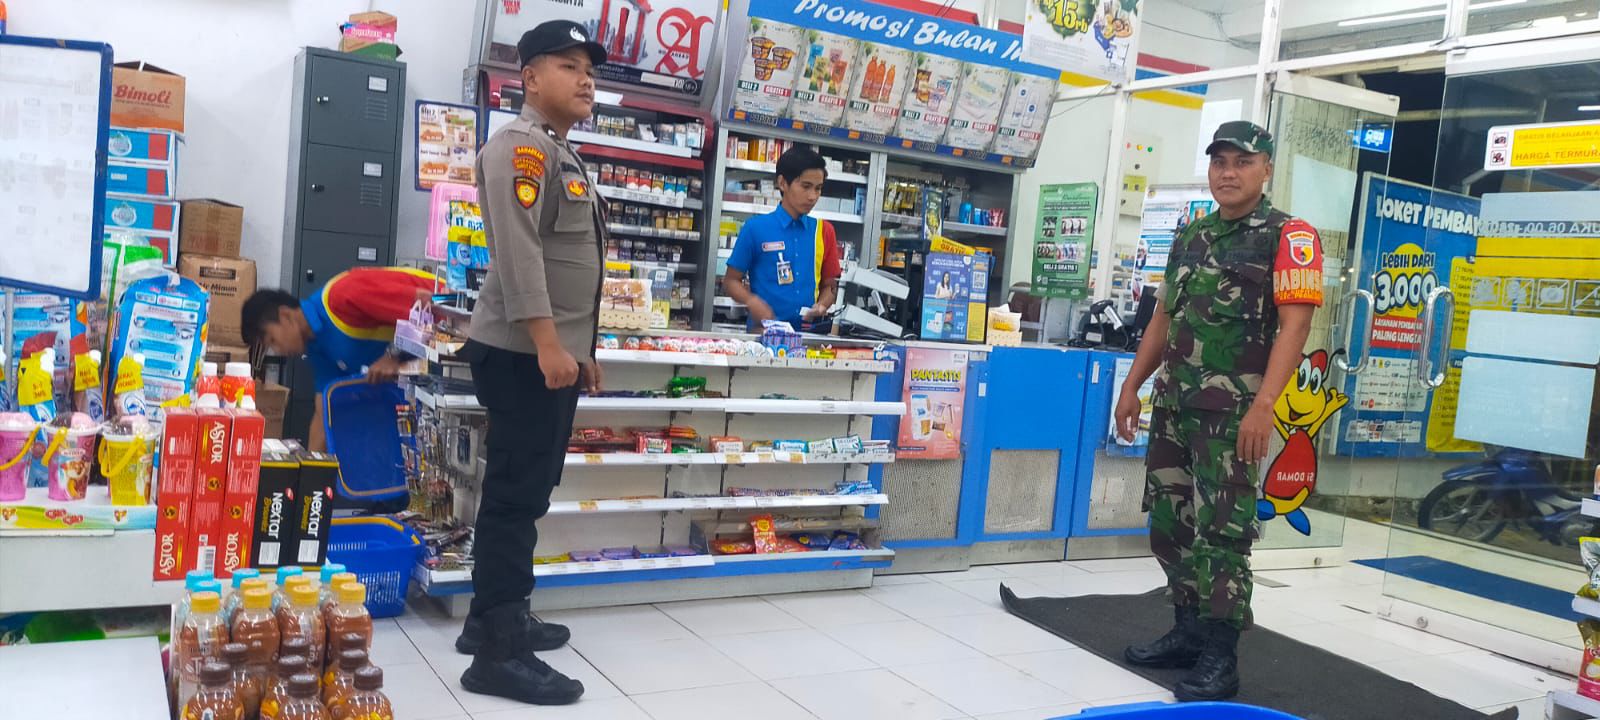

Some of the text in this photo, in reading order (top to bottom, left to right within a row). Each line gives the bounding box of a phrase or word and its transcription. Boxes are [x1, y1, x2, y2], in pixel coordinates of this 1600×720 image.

[655, 7, 714, 79] A
[794, 0, 914, 38] Promosi
[914, 22, 997, 54] Bulan
[114, 85, 172, 104] Bimoli
[765, 86, 784, 95] GRATIS
[1515, 152, 1550, 160] HARGA
[1412, 254, 1434, 268] DARI
[1376, 271, 1436, 314] 3.000
[1372, 330, 1396, 341] PALING
[210, 422, 225, 464] ASTOR
[160, 532, 176, 576] ASTOR
[224, 532, 240, 574] ASTOR
